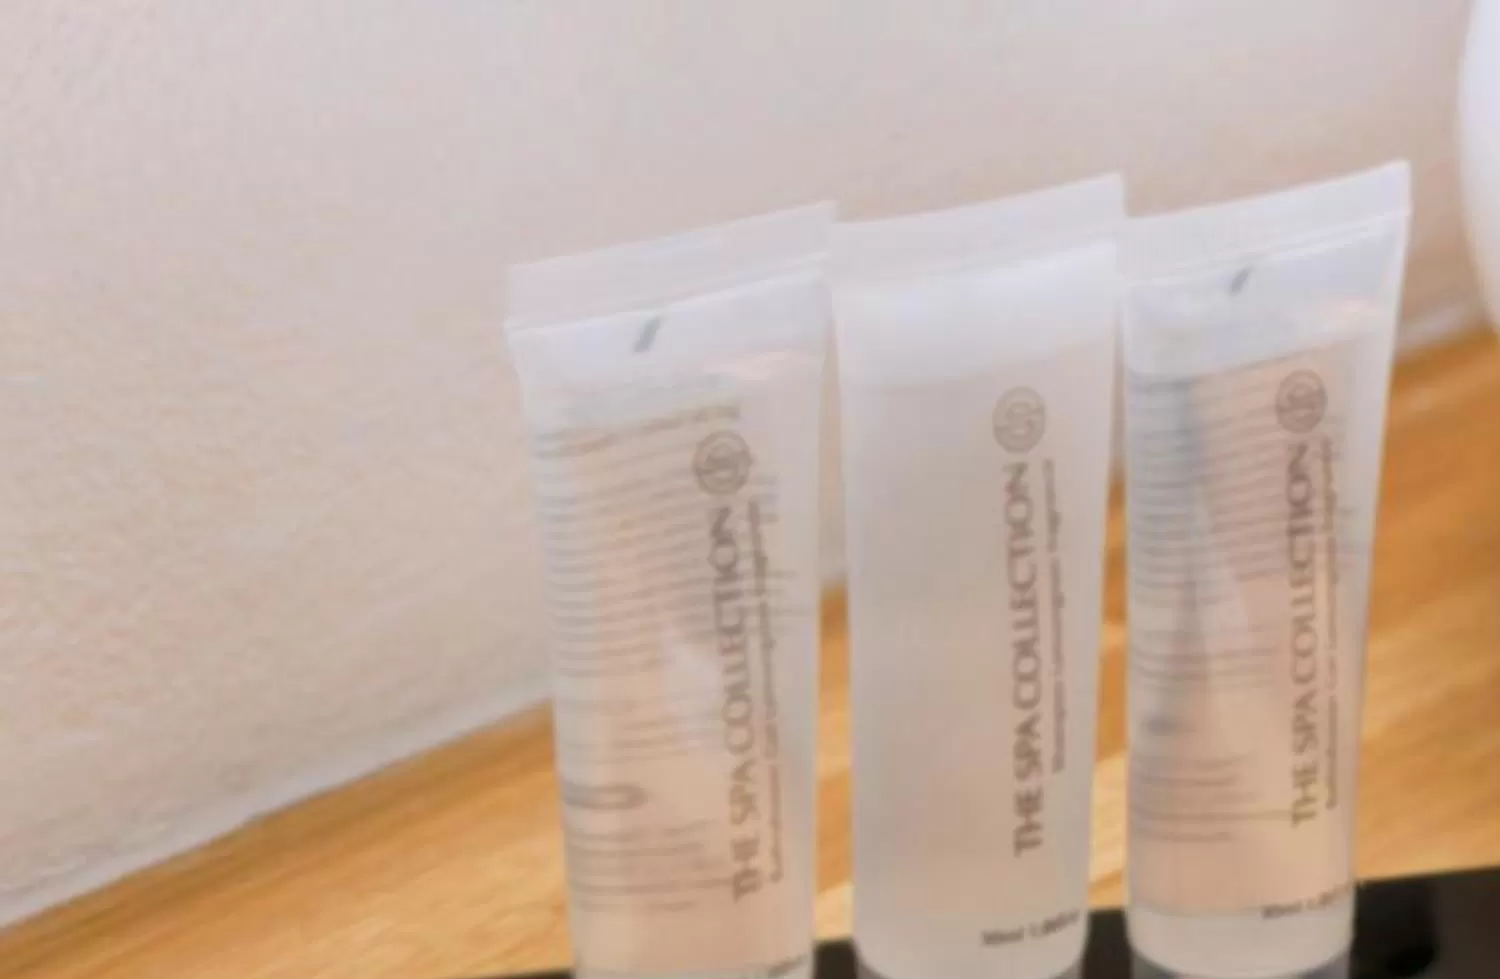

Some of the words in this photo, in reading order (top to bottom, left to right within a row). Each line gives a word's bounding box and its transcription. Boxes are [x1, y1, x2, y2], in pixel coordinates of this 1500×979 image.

[1002, 462, 1042, 711] COLLECTION
[1286, 443, 1318, 686] COLLECTION
[707, 506, 756, 757] COLLECTION
[1012, 712, 1043, 783] SPA
[1290, 688, 1319, 756] SPA
[729, 758, 762, 826] SPA
[1012, 786, 1044, 858] THE
[1290, 760, 1319, 829] THE
[730, 828, 764, 904] THE
